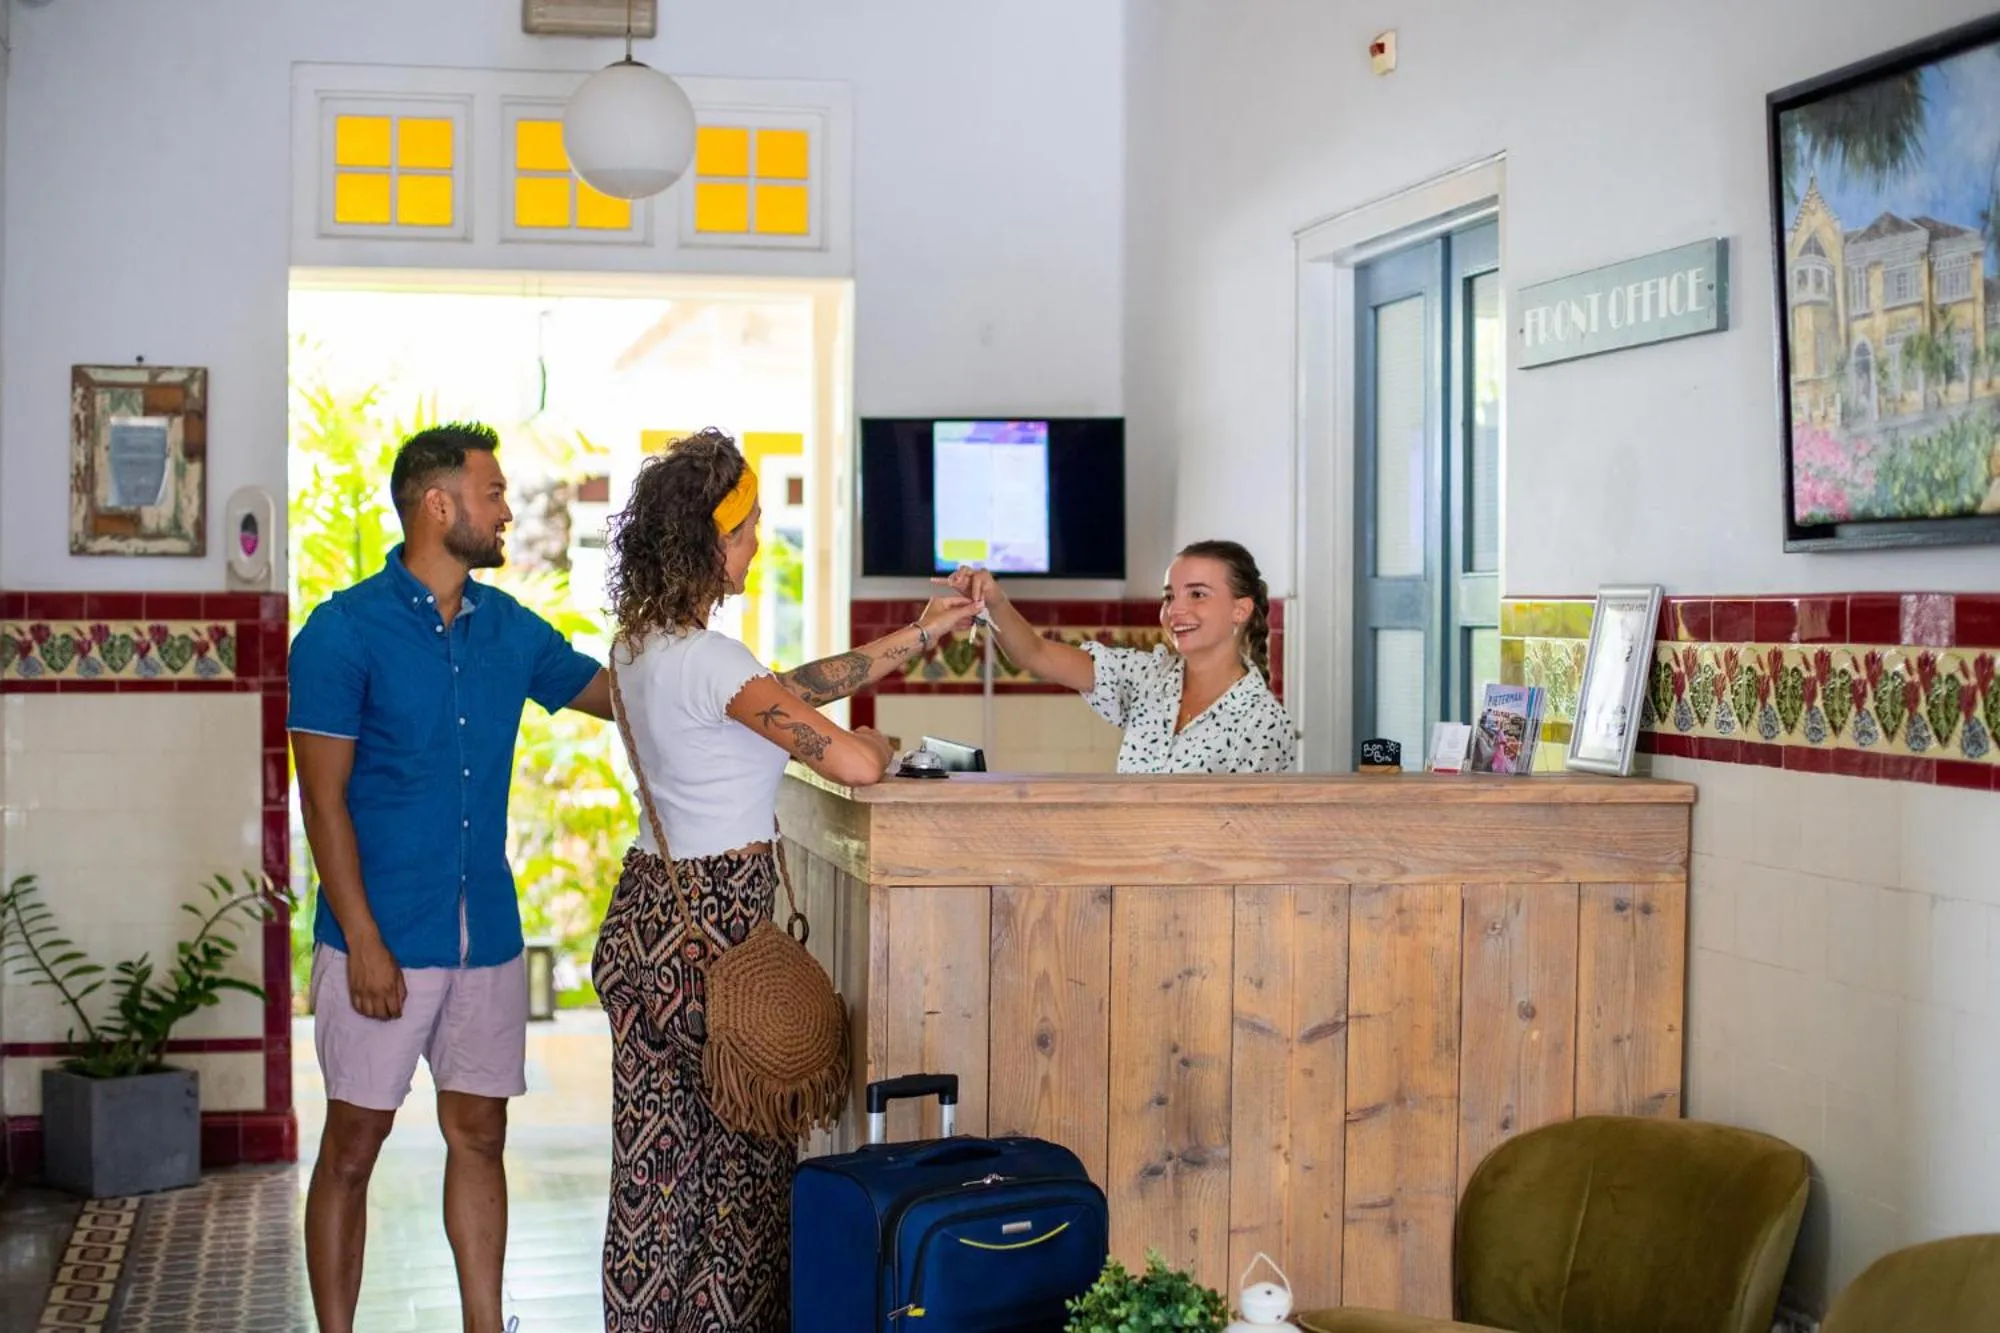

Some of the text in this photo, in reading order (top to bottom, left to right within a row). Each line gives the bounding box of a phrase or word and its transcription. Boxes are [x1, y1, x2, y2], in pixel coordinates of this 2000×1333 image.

[1525, 267, 1705, 347] FRONT OFFICE
[1363, 743, 1383, 757] Bon
